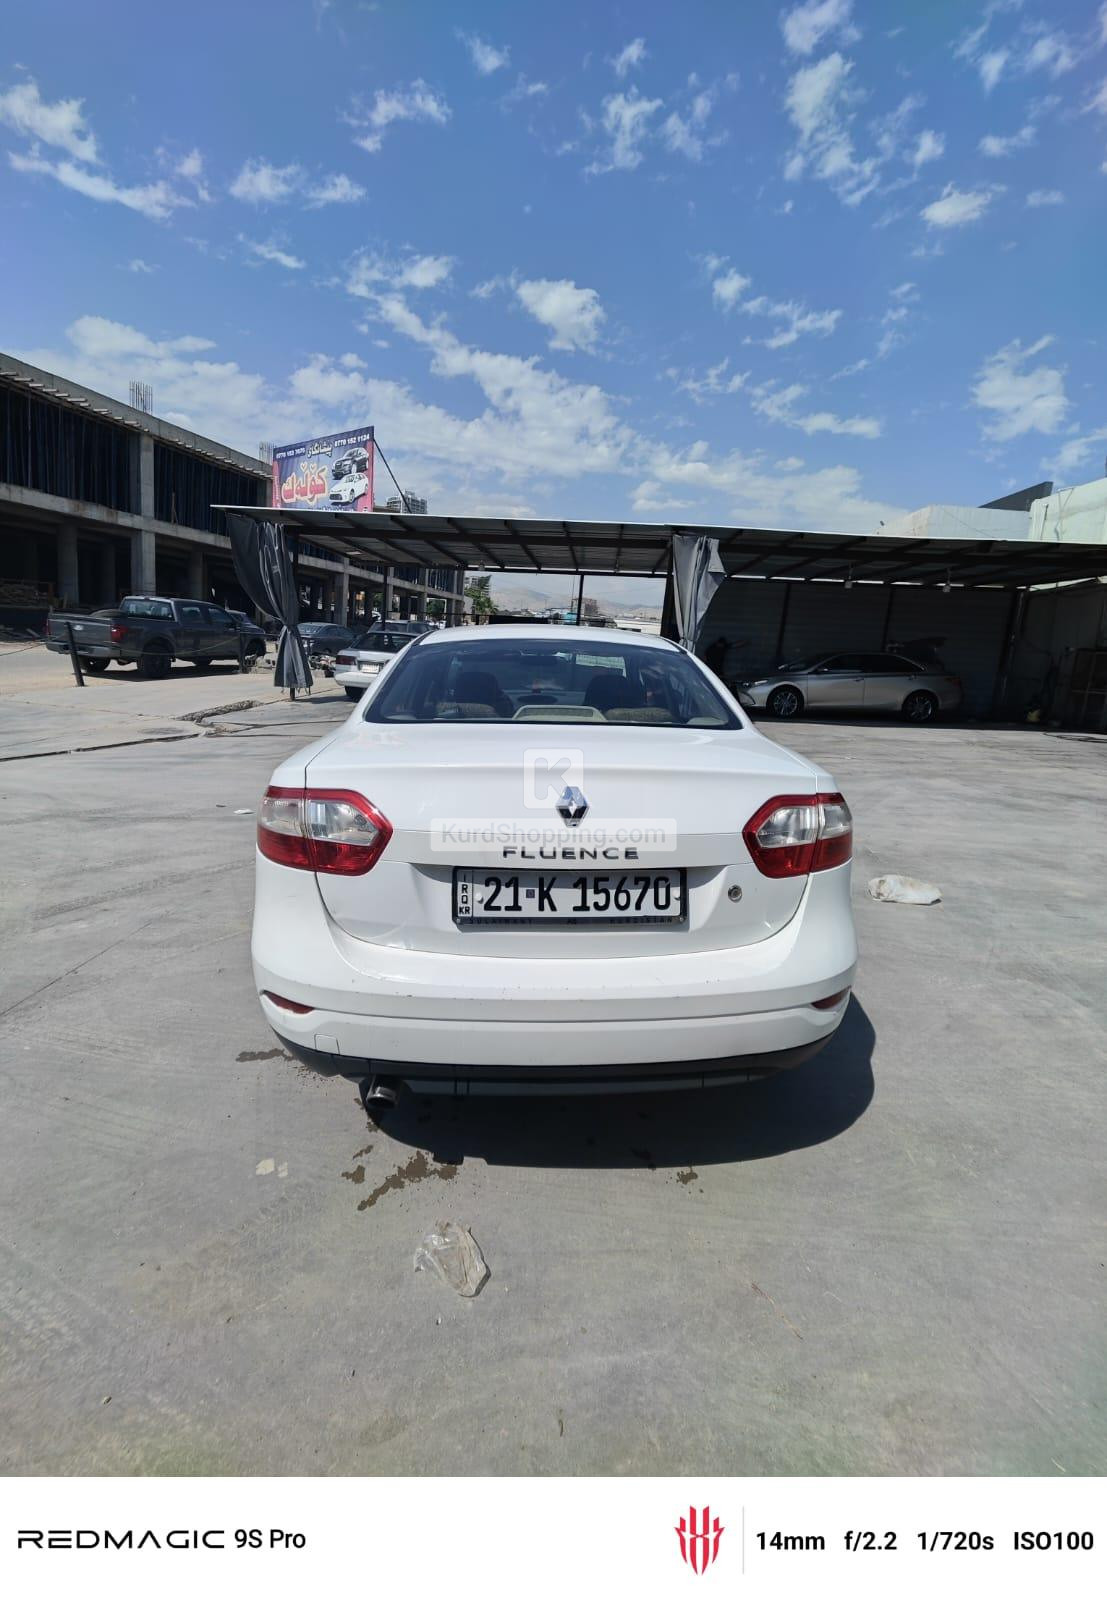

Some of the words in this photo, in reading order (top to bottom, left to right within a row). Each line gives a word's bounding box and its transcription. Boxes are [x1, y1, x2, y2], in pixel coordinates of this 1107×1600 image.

[503, 846, 640, 860] FLUENCE
[484, 876, 523, 912] 21
[538, 876, 558, 912] K
[572, 876, 671, 912] 15670
[459, 906, 471, 915] KR
